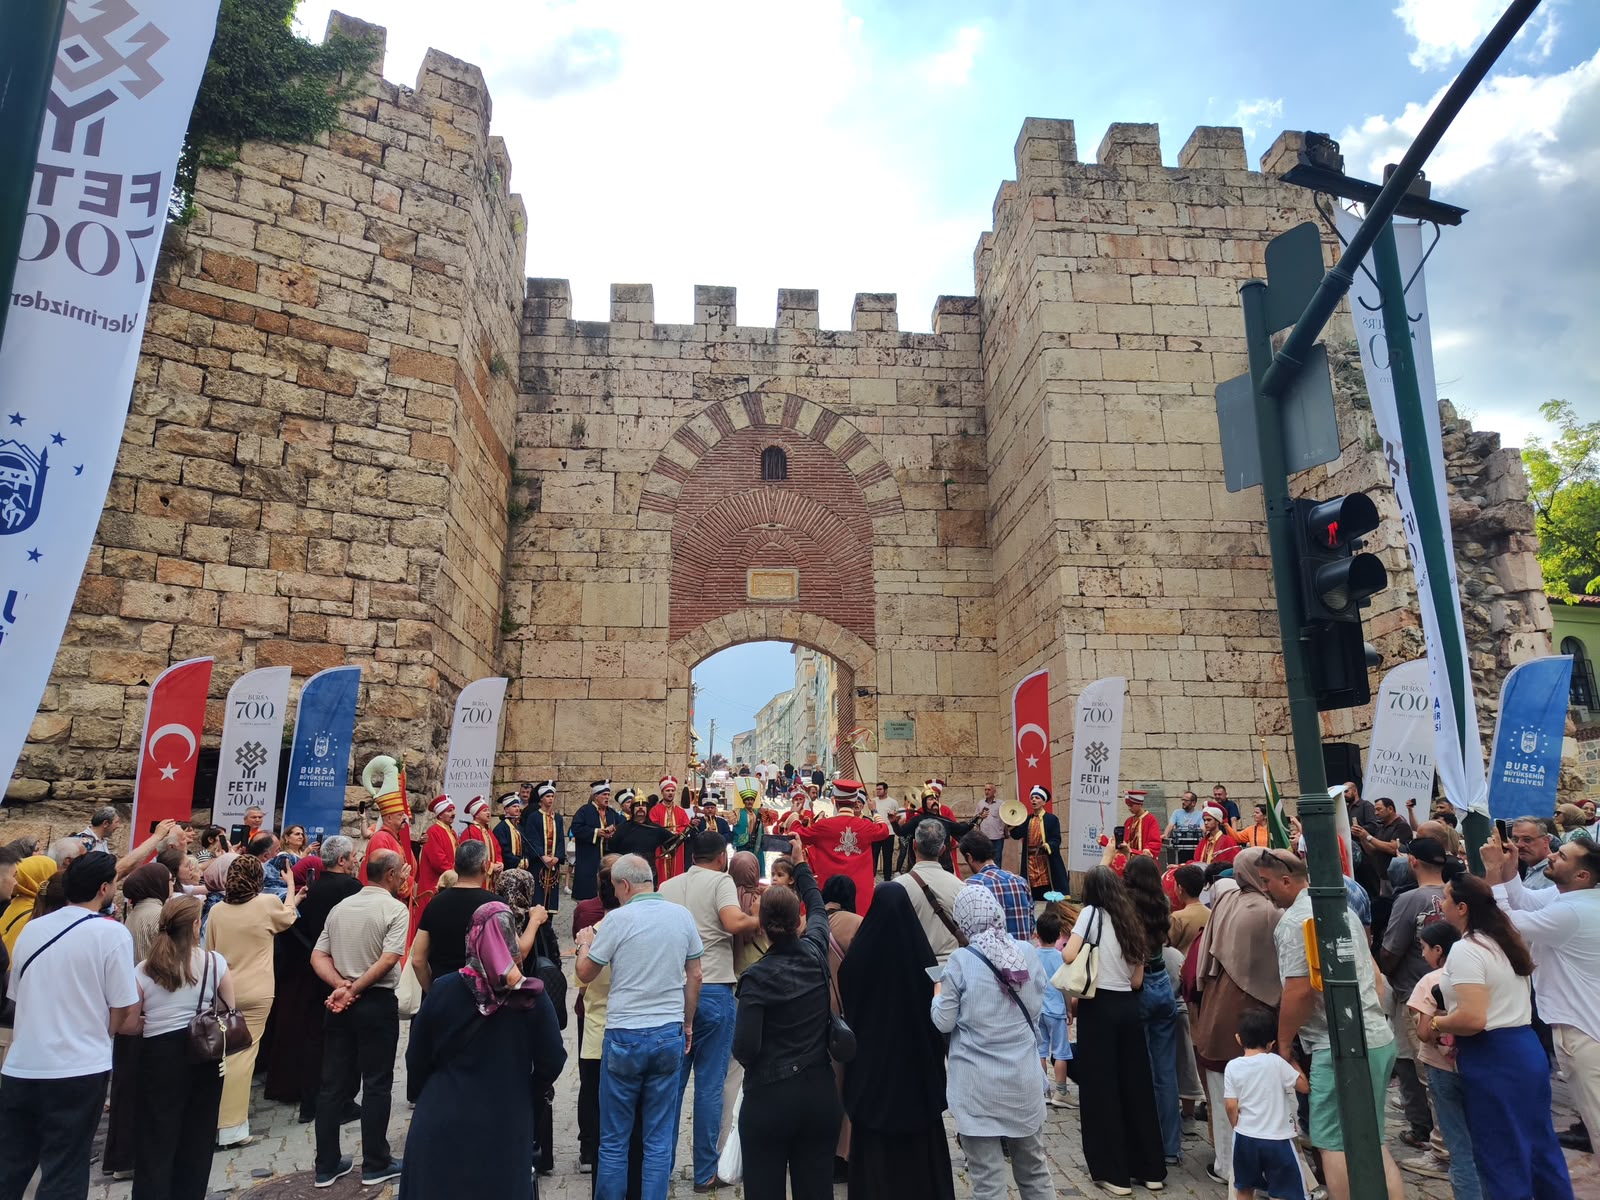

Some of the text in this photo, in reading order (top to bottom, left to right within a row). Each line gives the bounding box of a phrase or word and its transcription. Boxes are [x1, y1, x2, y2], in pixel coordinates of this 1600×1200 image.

[1401, 684, 1425, 693] BURSA
[1388, 691, 1429, 711] 700
[235, 700, 275, 720] 700
[461, 706, 492, 724] 700
[1083, 707, 1113, 723] 700
[475, 758, 492, 767] YIL
[1376, 748, 1432, 767] 700. YIL
[300, 766, 336, 775] BURSA
[1373, 763, 1431, 781] MEYDAN
[1505, 761, 1546, 774] BURSA
[448, 771, 490, 781] MEYDAN
